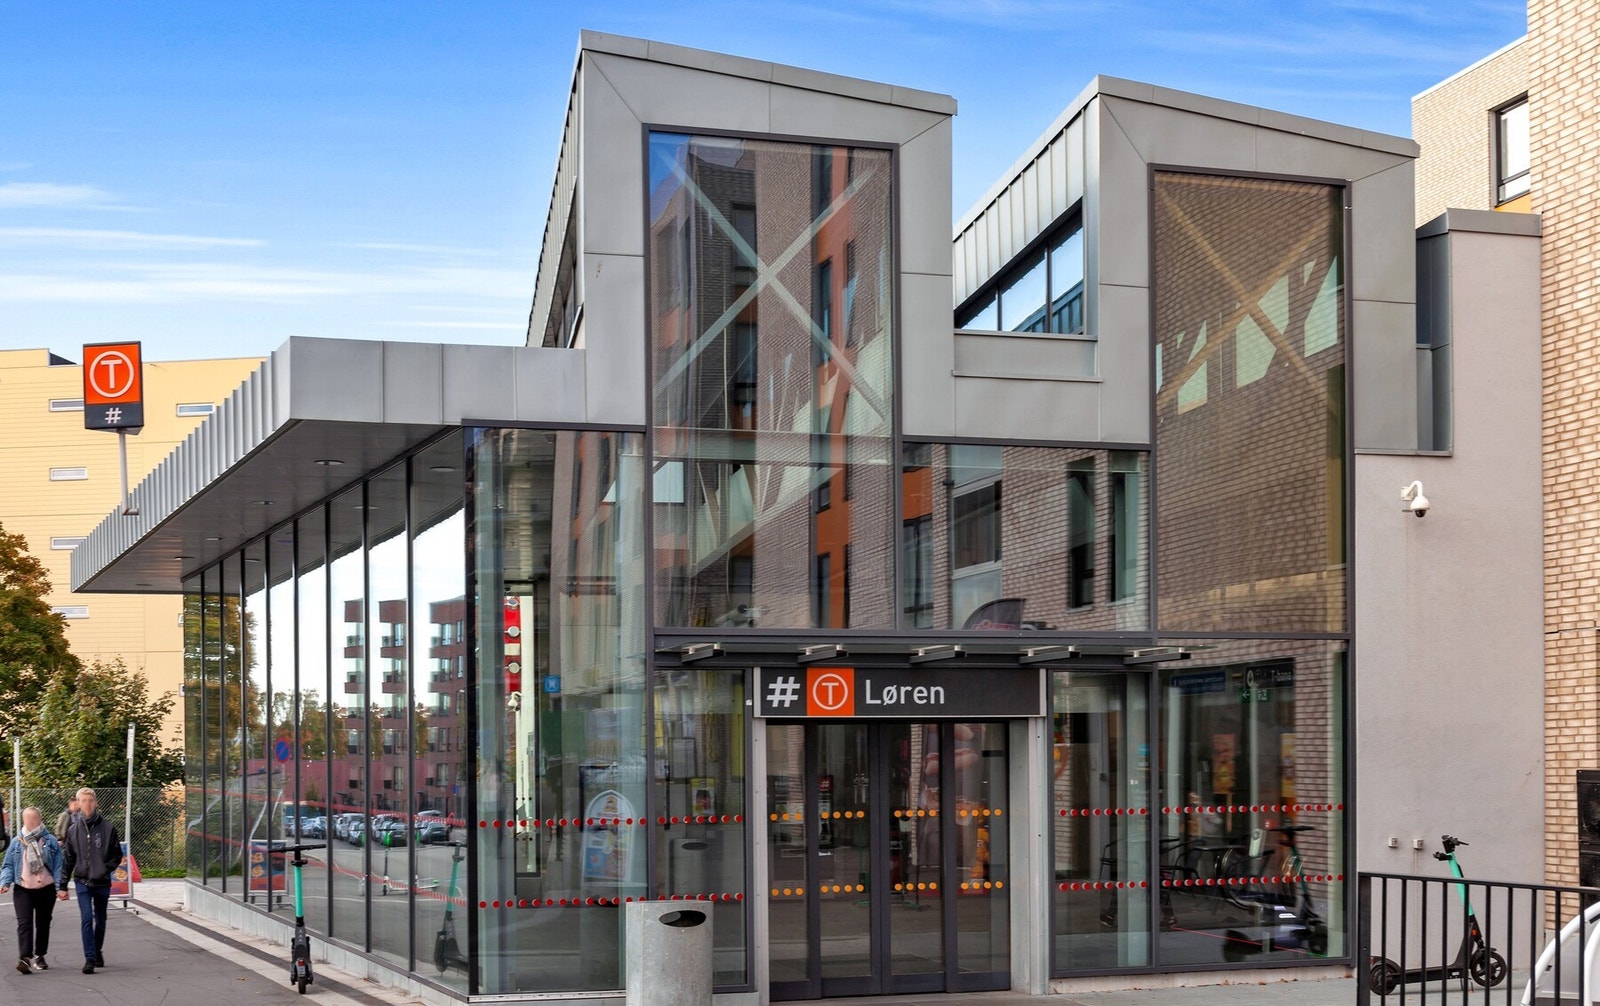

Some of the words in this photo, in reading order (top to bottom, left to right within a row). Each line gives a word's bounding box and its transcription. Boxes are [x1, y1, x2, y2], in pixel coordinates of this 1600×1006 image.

[100, 359, 123, 389] T
[105, 407, 122, 424] #
[766, 676, 801, 708] #
[822, 682, 839, 705] T
[865, 679, 945, 706] Løren
